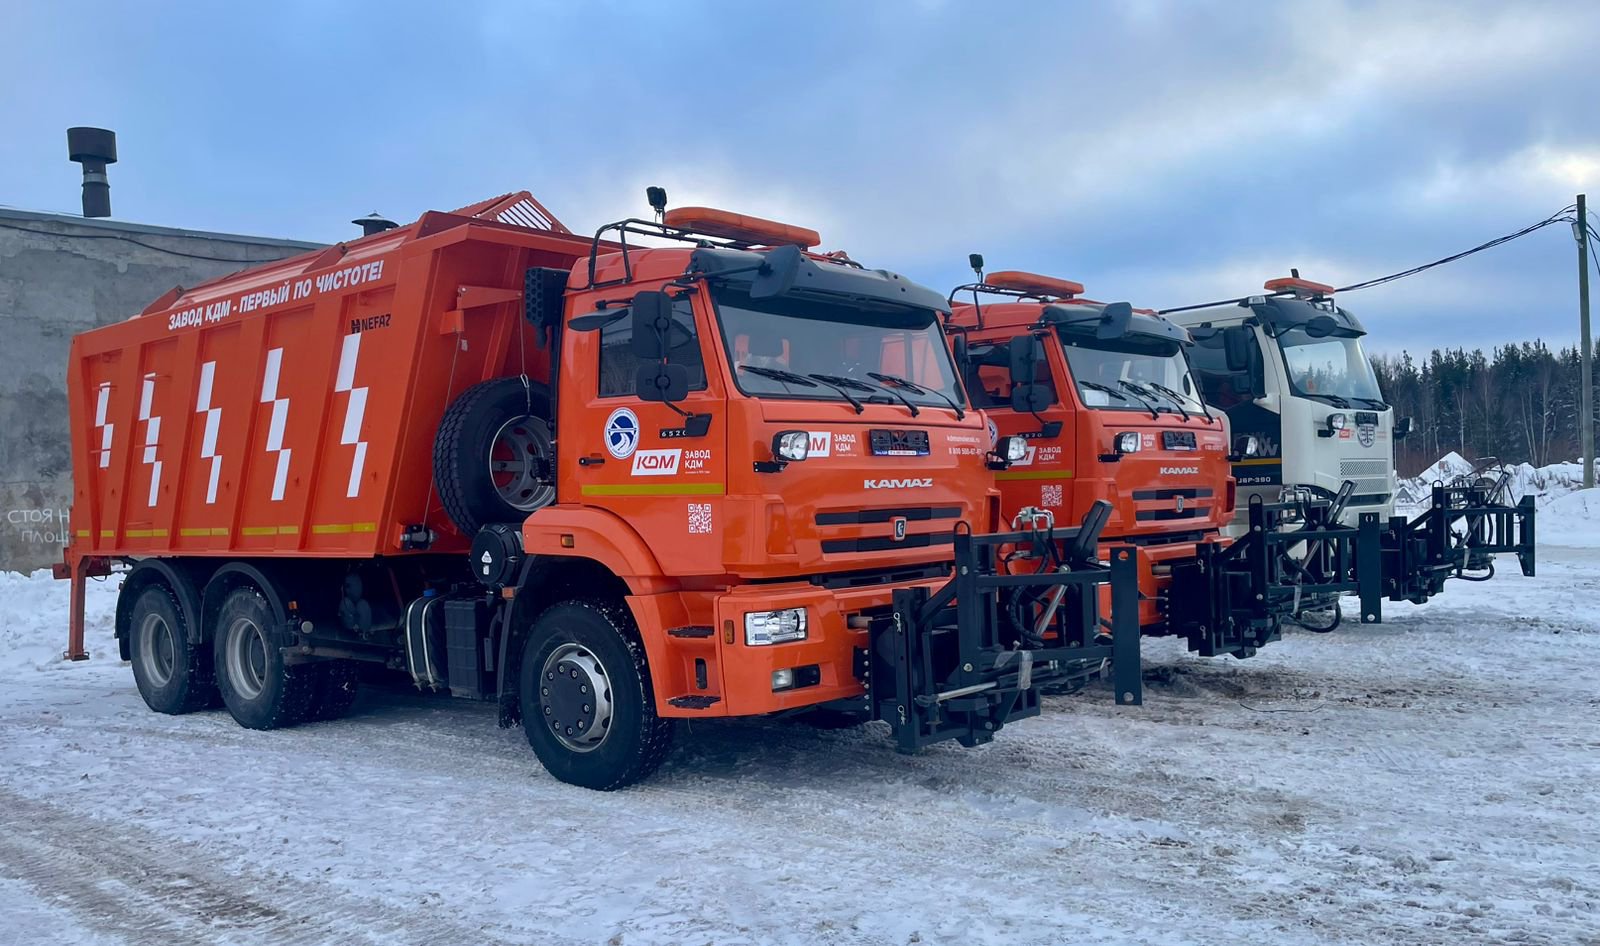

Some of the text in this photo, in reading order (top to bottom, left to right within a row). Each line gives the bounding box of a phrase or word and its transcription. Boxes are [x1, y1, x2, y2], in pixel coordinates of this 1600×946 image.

[168, 306, 202, 330] ЗАВОД
[205, 300, 231, 323] КДМ
[239, 281, 291, 314] ПЕРВЫЙ
[293, 281, 312, 299] ПО
[316, 260, 385, 293] ЧИСТОТЕ!
[361, 313, 391, 331] NEFAZ
[685, 450, 710, 459] ЗАВОД
[1038, 446, 1062, 454] ЗАВОД
[636, 454, 676, 469] KDM
[1038, 453, 1055, 461] КДМ
[685, 460, 703, 469] КДМ
[1160, 467, 1199, 475] KAMAZ
[863, 478, 933, 489] KAMAZ
